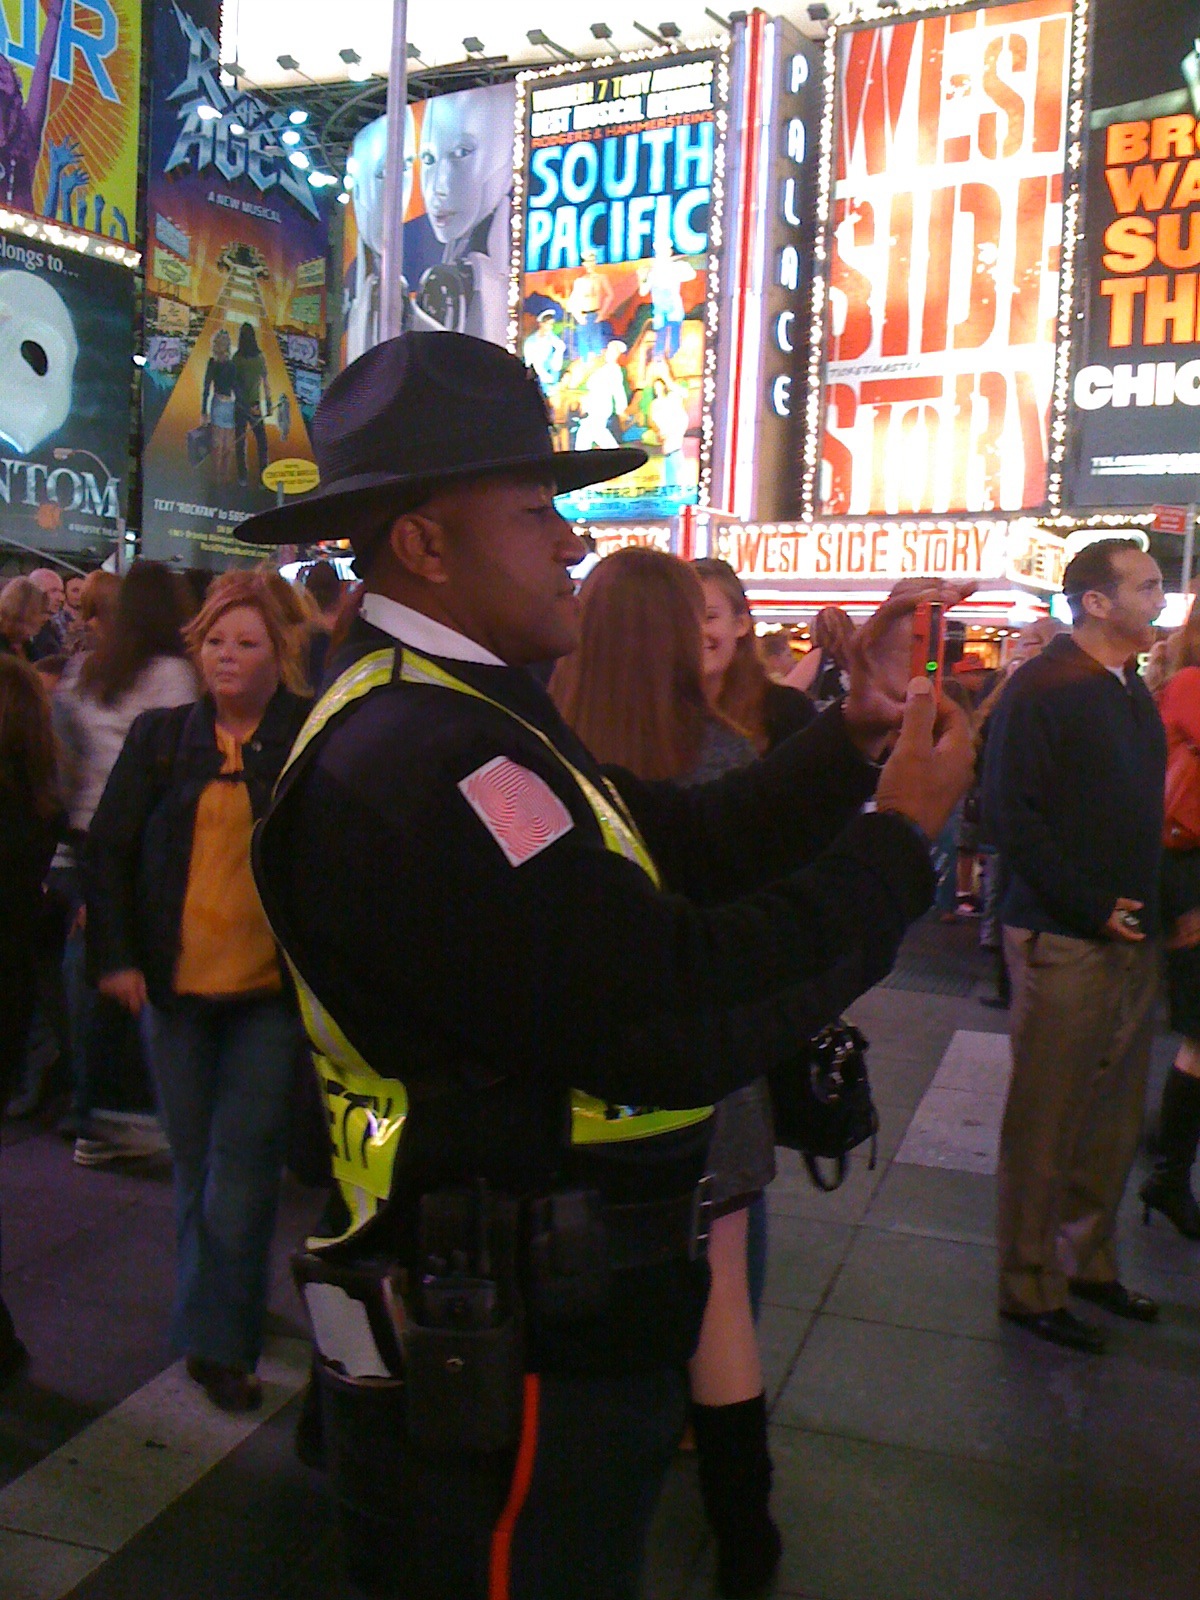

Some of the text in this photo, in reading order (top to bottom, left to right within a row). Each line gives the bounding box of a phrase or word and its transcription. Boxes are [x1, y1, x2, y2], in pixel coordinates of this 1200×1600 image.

[838, 0, 1075, 183] WEST
[529, 121, 714, 209] SOUTH
[1104, 113, 1200, 167] BR
[0, 236, 45, 271] longs
[525, 187, 711, 273] PACIFIC
[772, 53, 811, 418] PALACE
[828, 173, 1065, 362] SIDE
[1100, 273, 1200, 348] TH
[735, 530, 808, 574] WEST
[815, 529, 889, 573] SIDE
[901, 525, 991, 573] STORY
